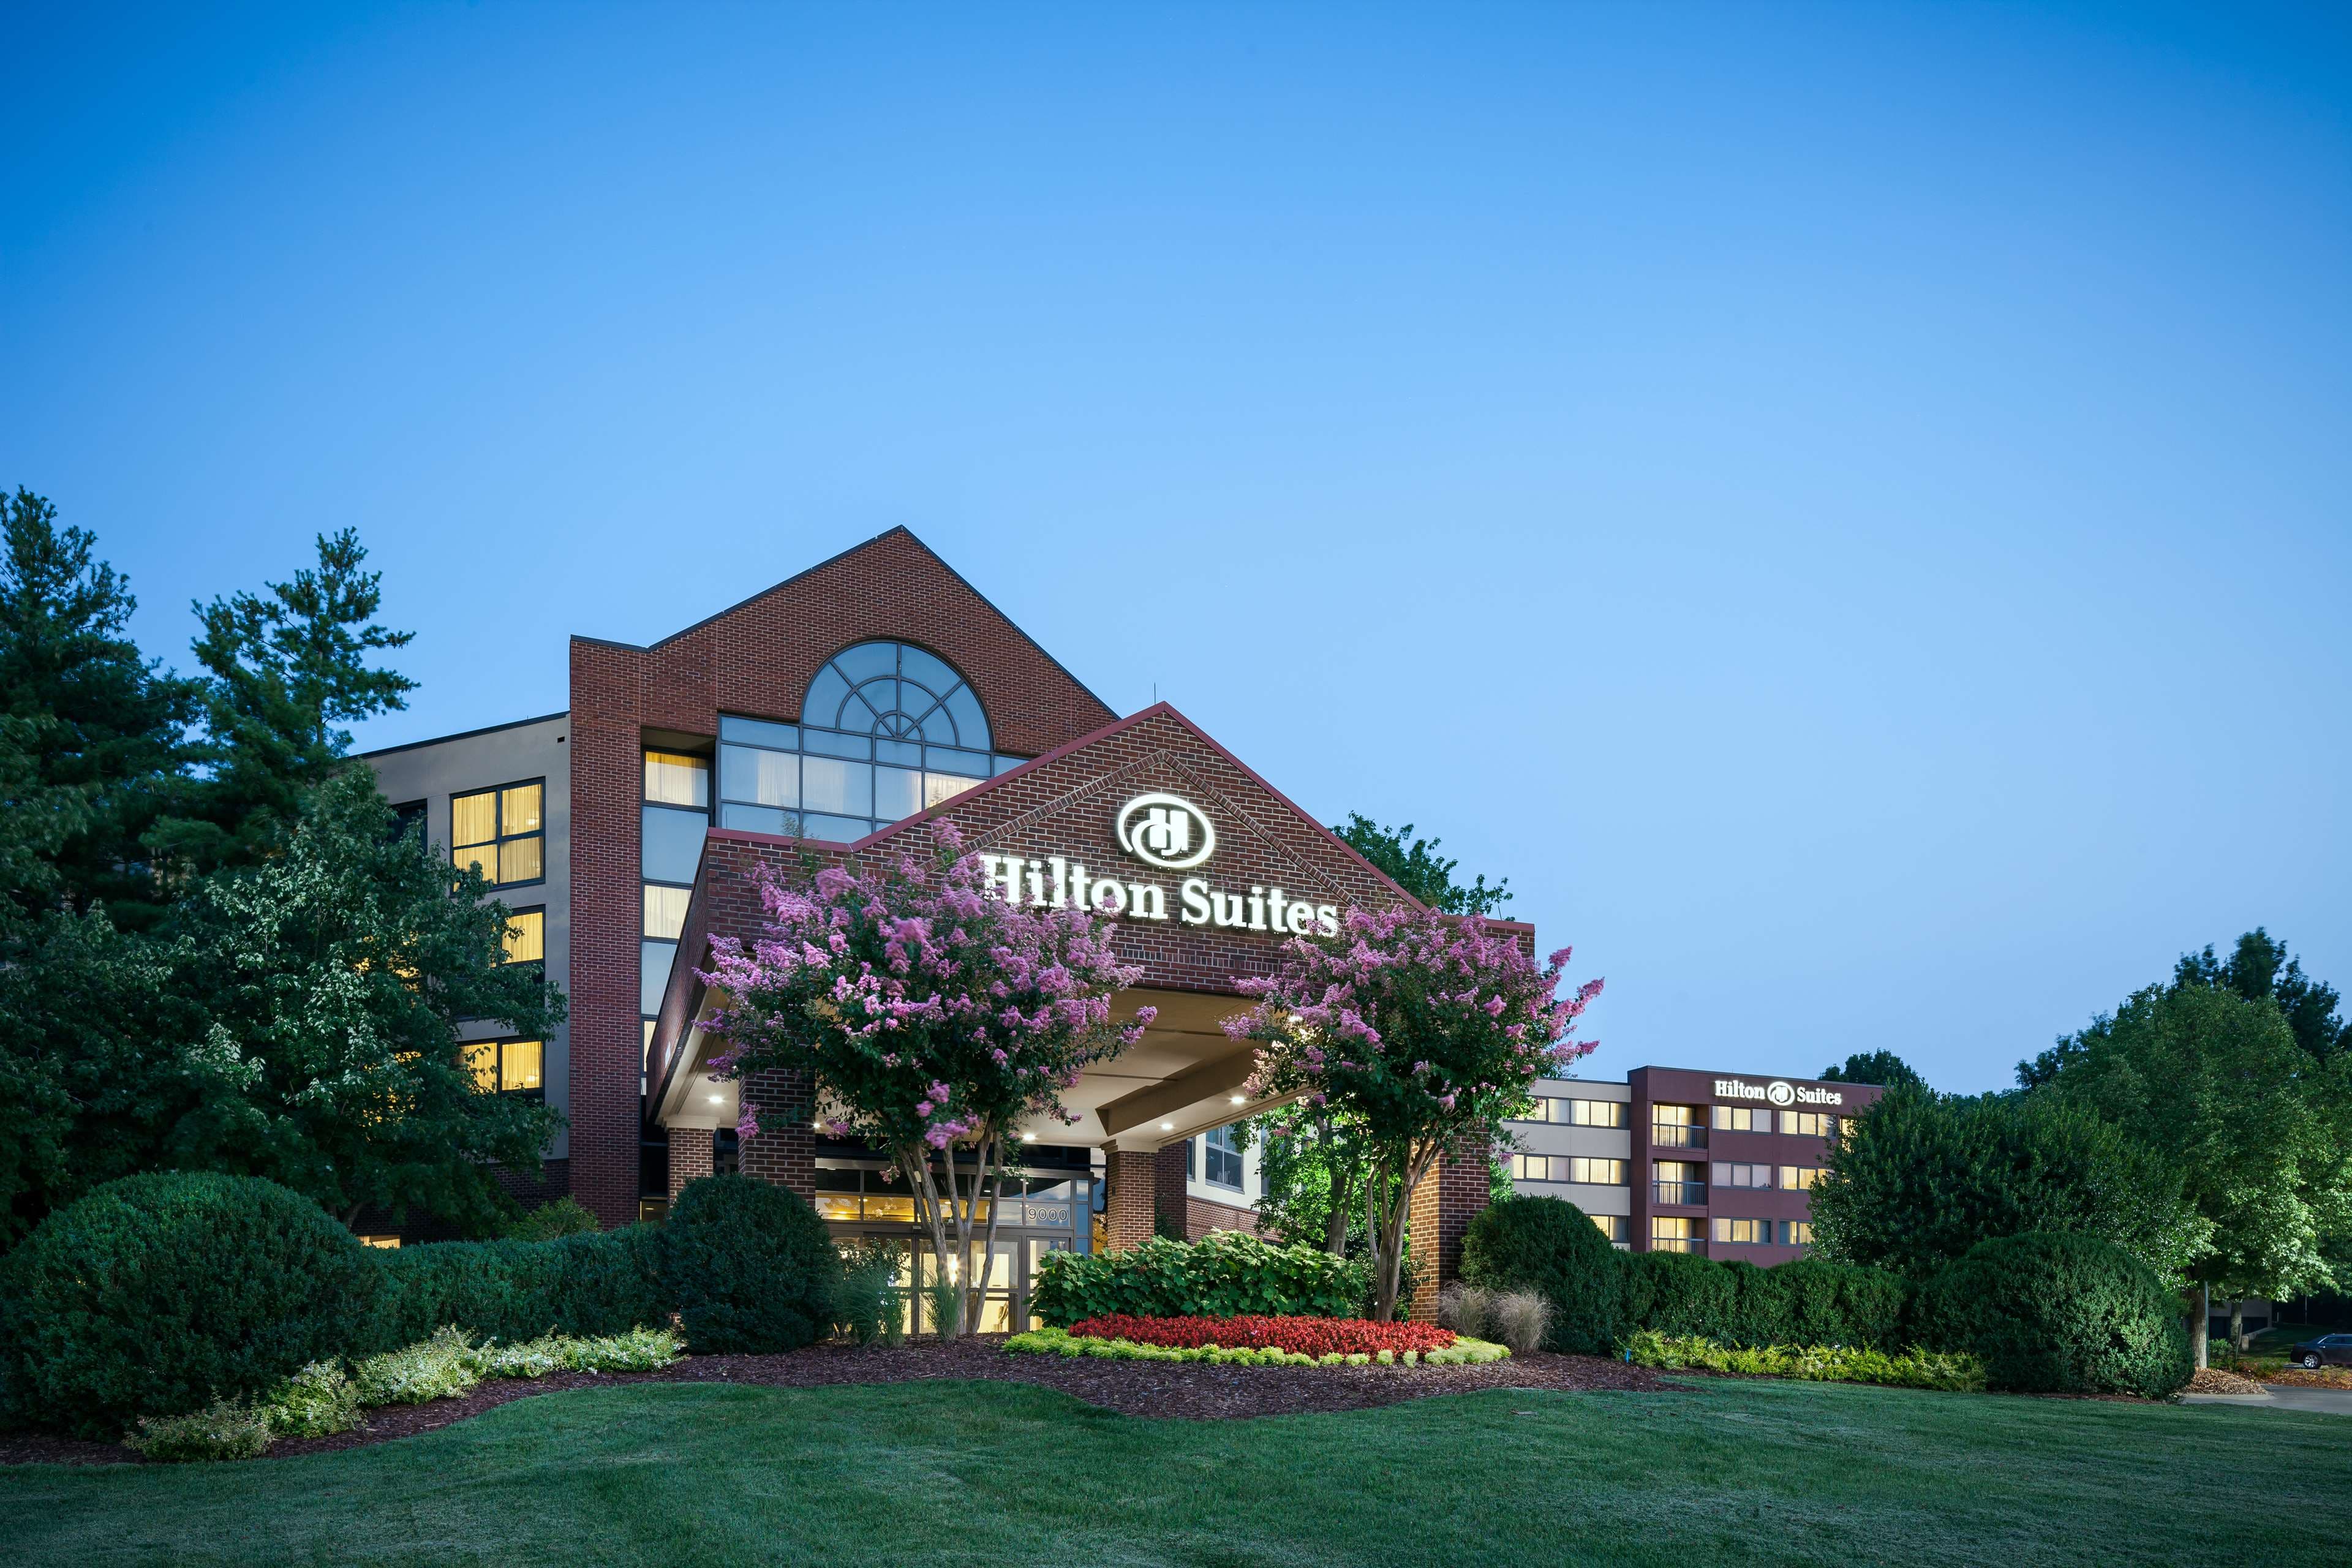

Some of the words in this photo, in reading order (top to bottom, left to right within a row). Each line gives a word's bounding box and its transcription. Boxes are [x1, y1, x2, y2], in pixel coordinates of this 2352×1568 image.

[981, 856, 1168, 919] Hilton
[1181, 878, 1337, 937] Suites
[1714, 1080, 1765, 1099] Hilton
[1796, 1087, 1842, 1105] Suites
[1028, 1208, 1068, 1221] 9000
